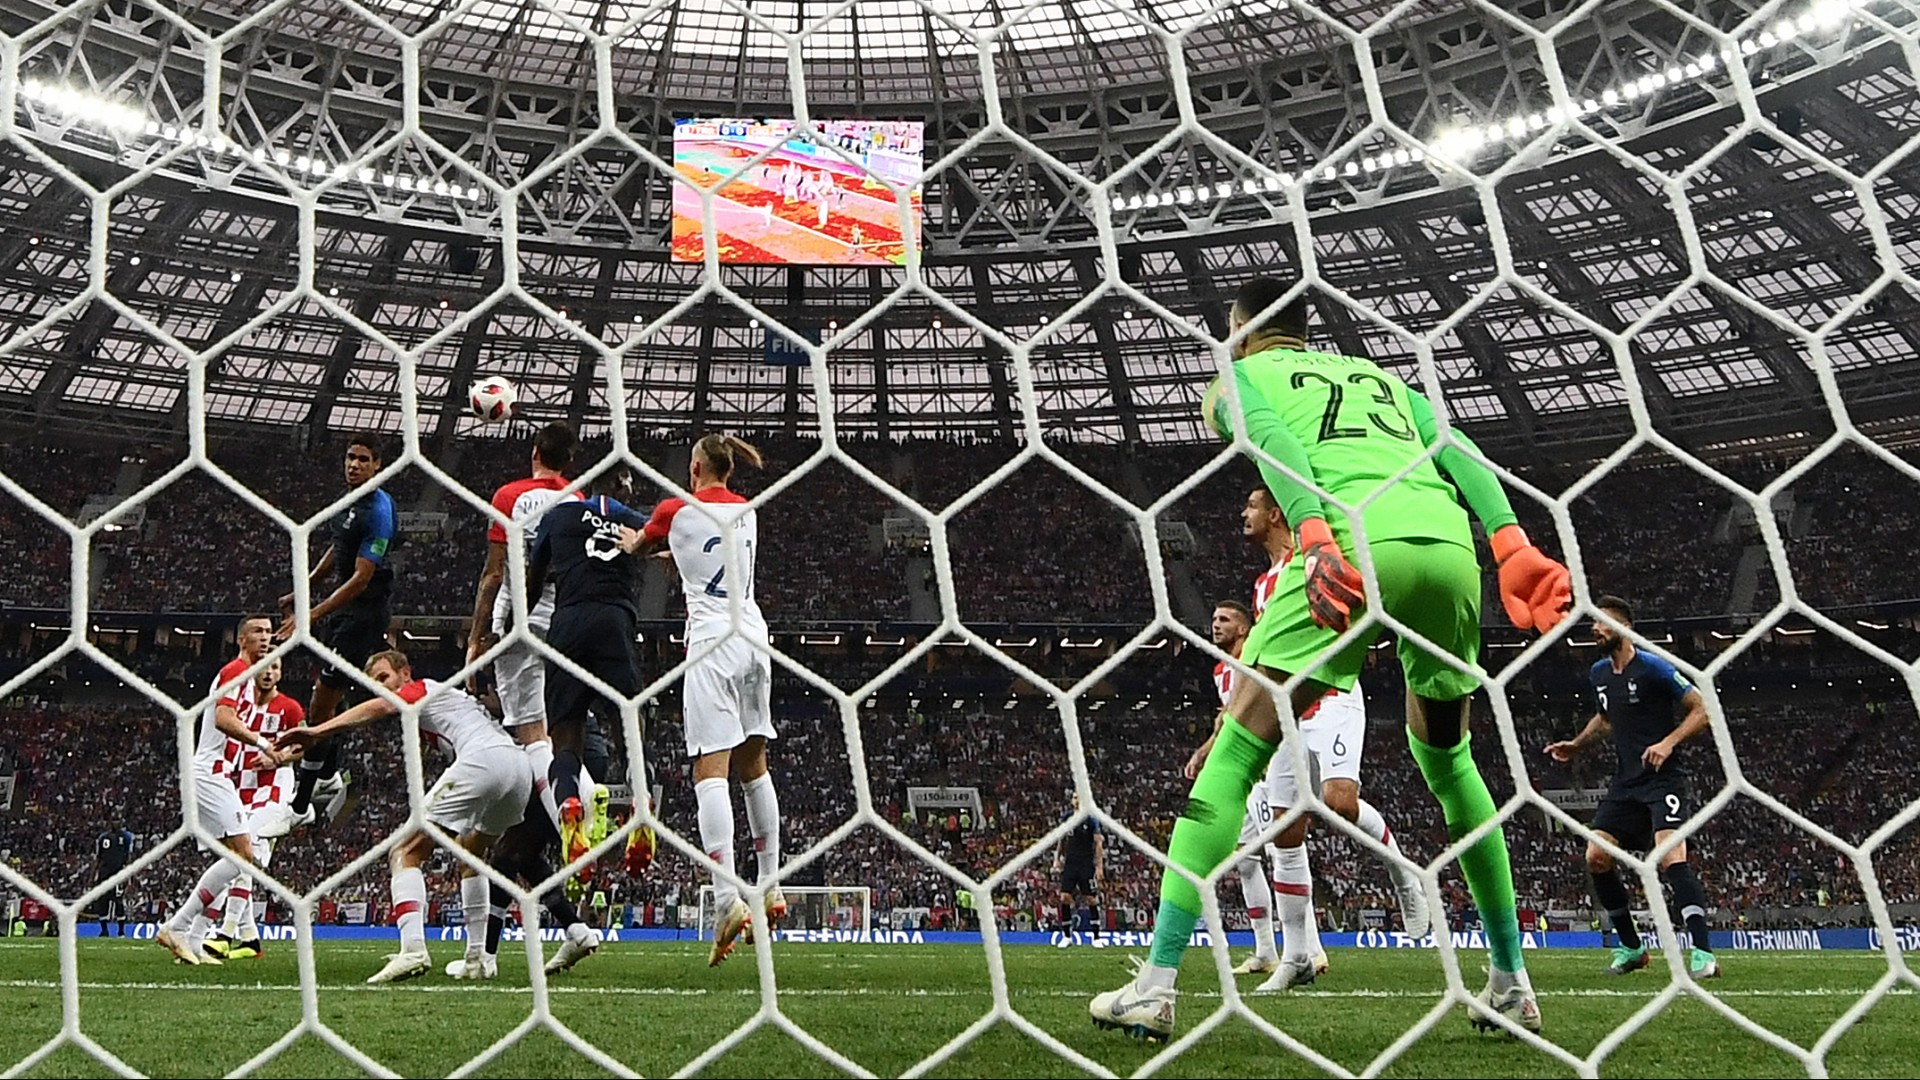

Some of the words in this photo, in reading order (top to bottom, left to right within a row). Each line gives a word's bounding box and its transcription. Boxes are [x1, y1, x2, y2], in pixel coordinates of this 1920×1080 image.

[1290, 371, 1415, 444] 23
[1332, 733, 1347, 757] 6
[1256, 800, 1271, 823] 18
[1665, 793, 1681, 815] 9
